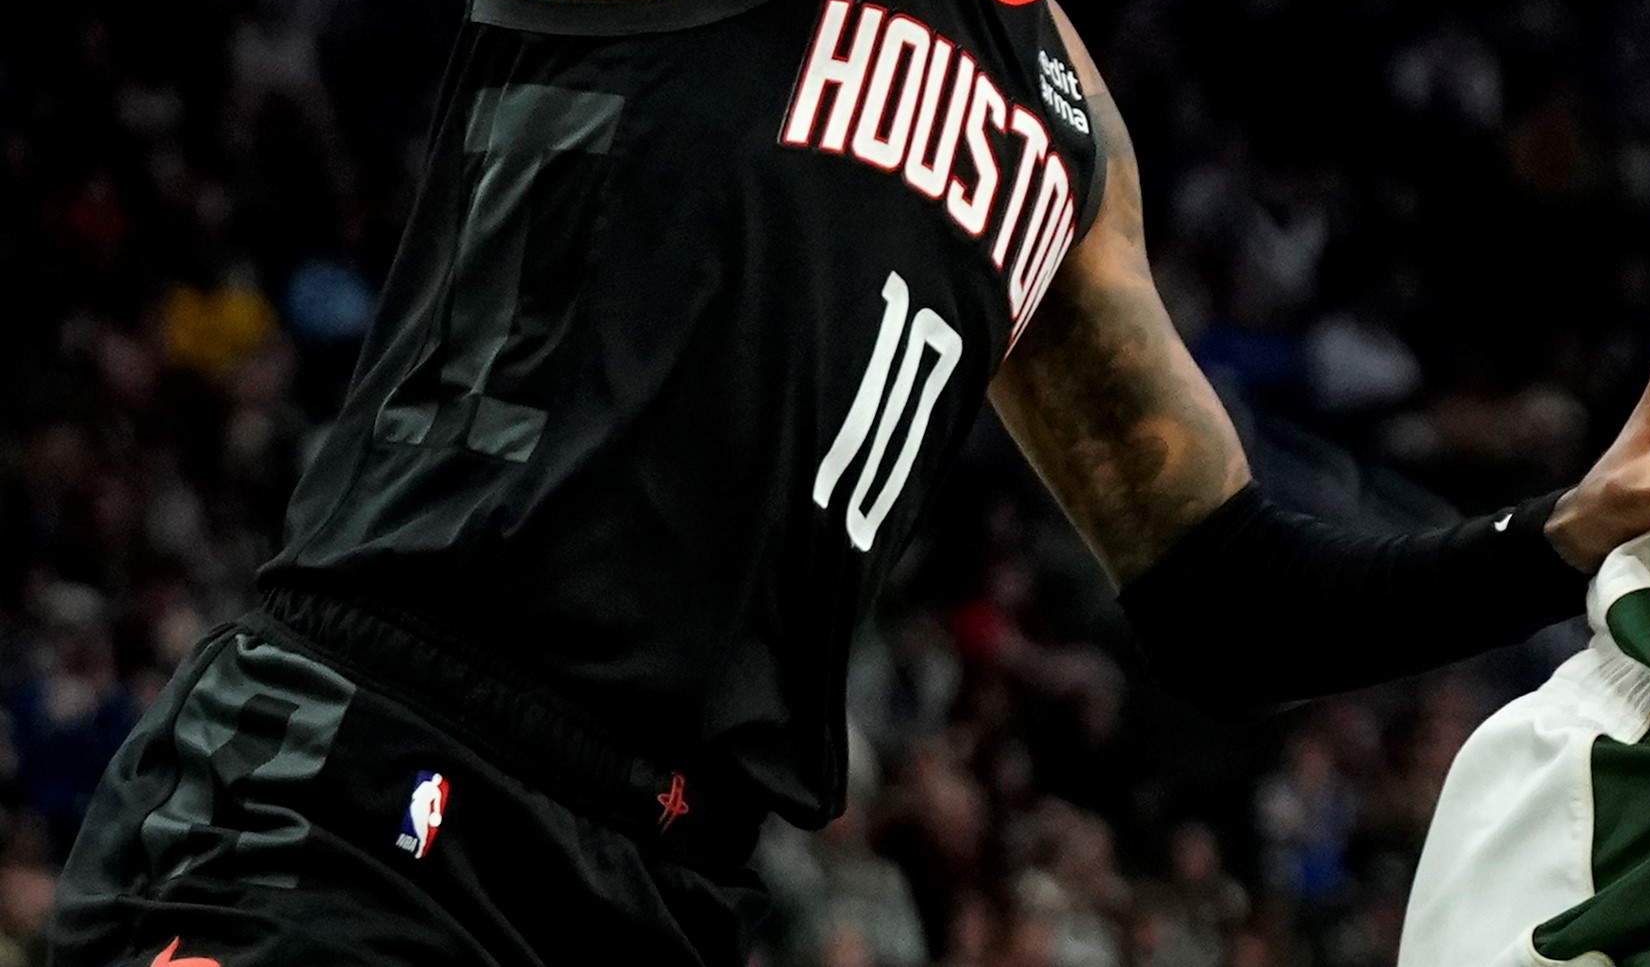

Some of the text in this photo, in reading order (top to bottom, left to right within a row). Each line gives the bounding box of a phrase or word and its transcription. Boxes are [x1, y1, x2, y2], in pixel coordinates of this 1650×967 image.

[1039, 50, 1082, 101] edit
[1040, 73, 1090, 134] arma
[813, 270, 964, 553] 10
